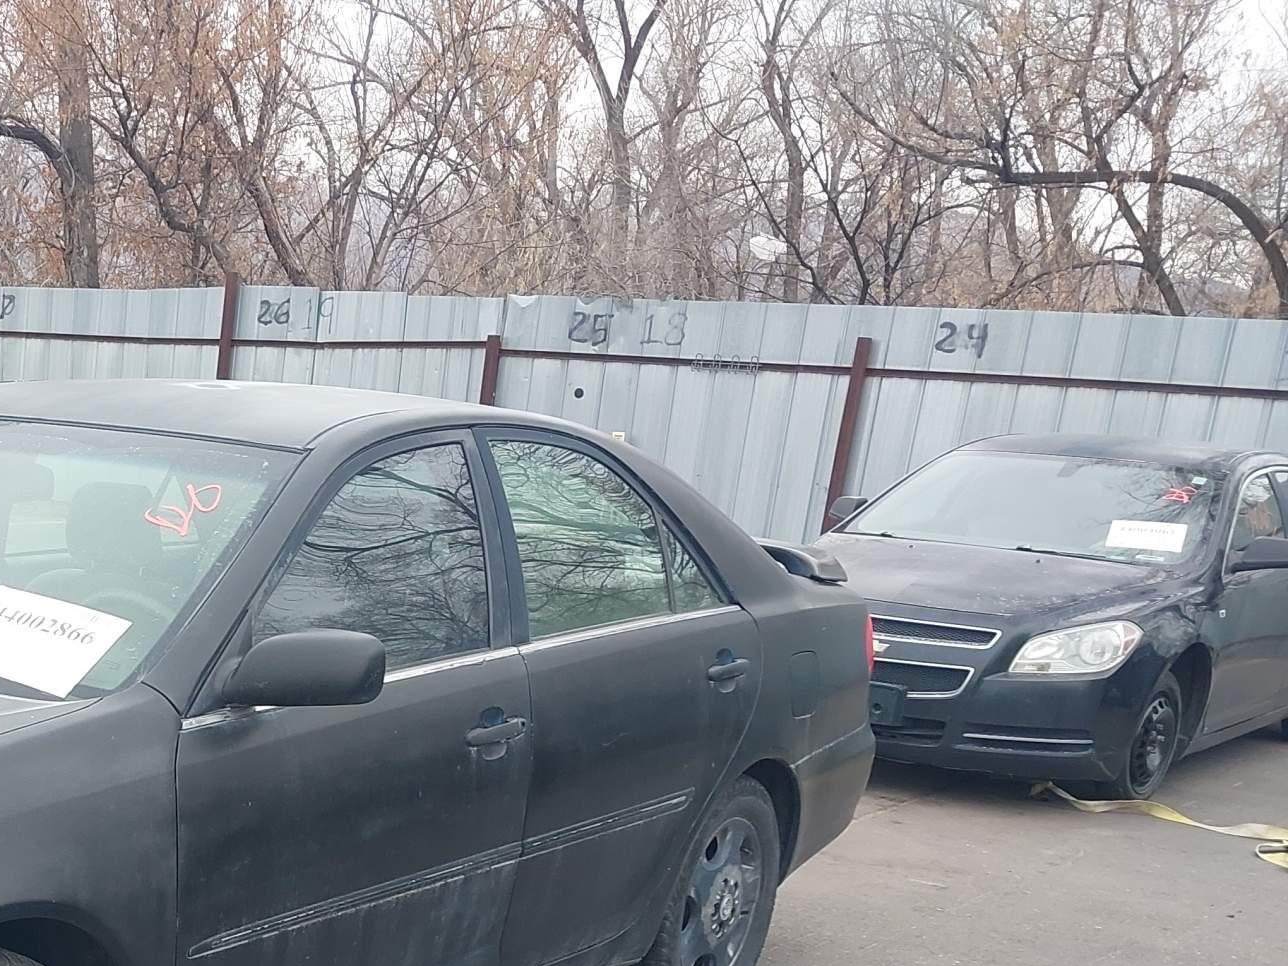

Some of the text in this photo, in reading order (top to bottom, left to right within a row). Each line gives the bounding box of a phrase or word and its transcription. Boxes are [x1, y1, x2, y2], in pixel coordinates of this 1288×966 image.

[257, 298, 291, 326] 26
[567, 311, 614, 347] 25
[639, 312, 688, 346] 18
[934, 321, 989, 359] 24
